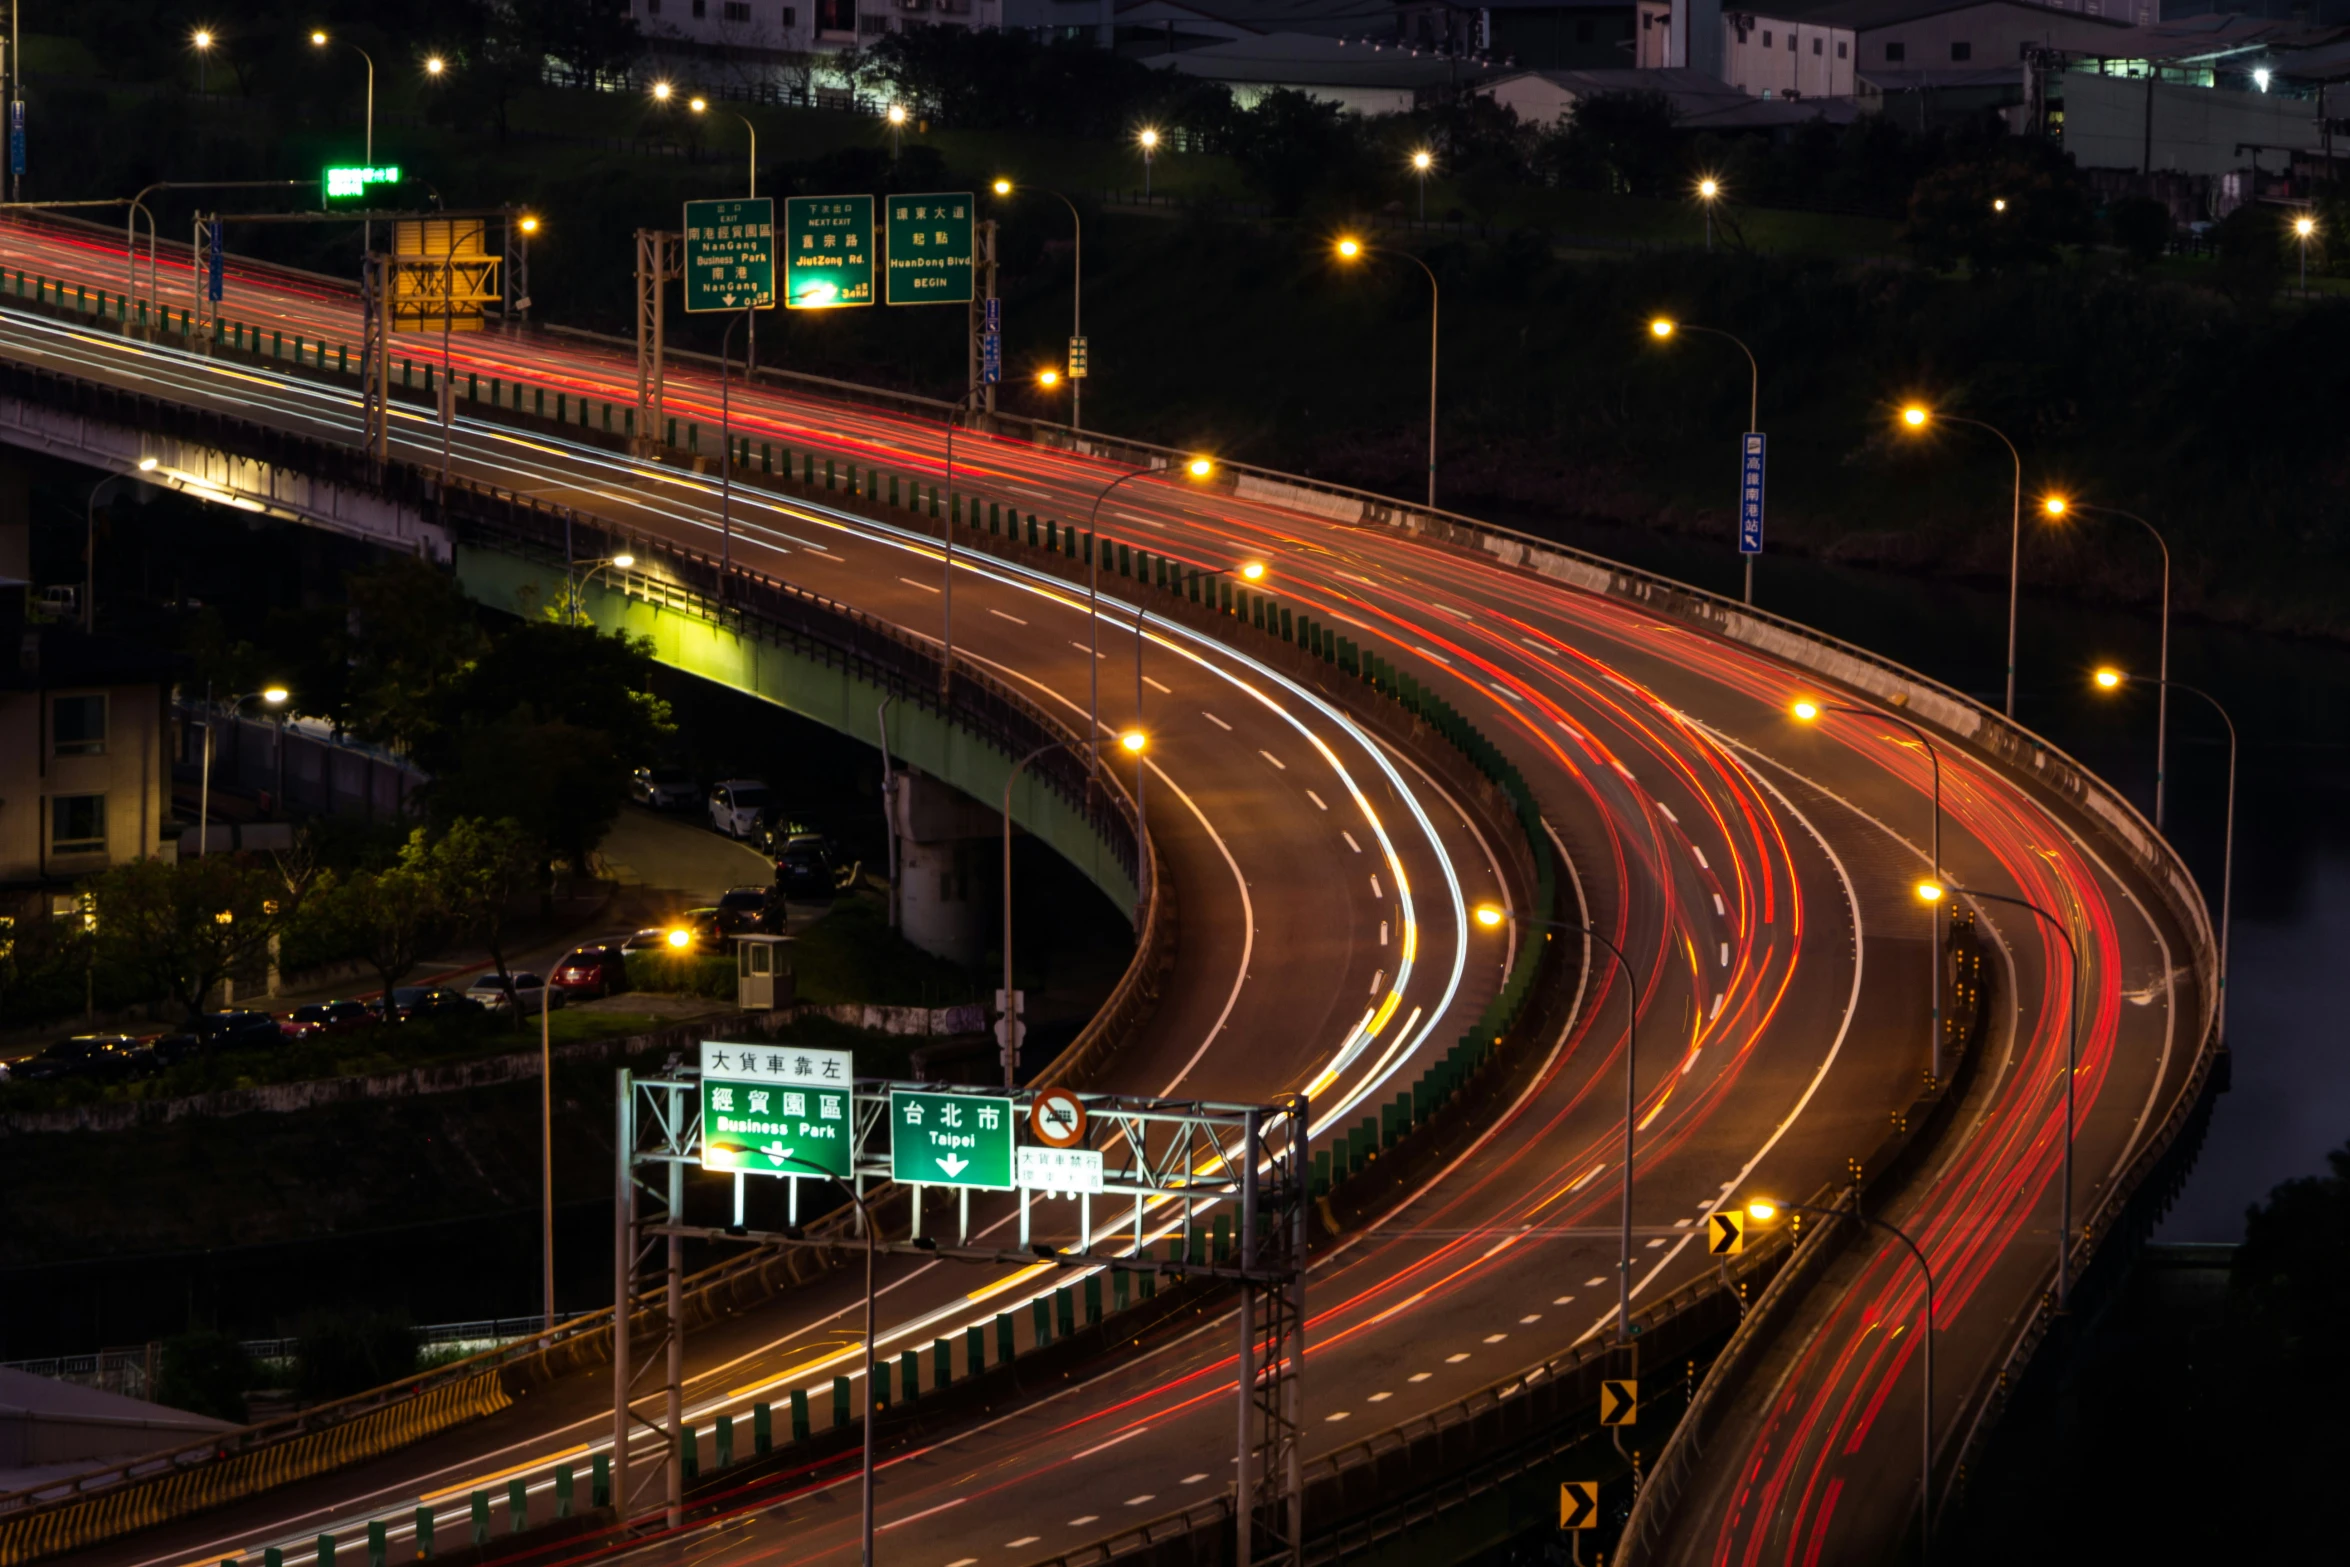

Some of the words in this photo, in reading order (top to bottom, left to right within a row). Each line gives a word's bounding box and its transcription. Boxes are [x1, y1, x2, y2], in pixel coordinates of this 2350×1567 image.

[810, 205, 851, 213] 下次出口
[897, 207, 964, 220] 環東大道
[689, 225, 770, 239] 南港經貿園區
[913, 232, 948, 245] 起點
[703, 242, 756, 251] NanGang
[803, 235, 857, 248] 舊宗路
[697, 256, 733, 265] Business
[742, 254, 765, 262] Park
[850, 255, 864, 263] Rd.
[891, 258, 944, 268] HuanDong
[713, 267, 746, 279] 南港
[704, 283, 756, 292] NanGang
[915, 279, 947, 287] BEGIN
[1745, 457, 1760, 532] 高鐵南港站
[712, 1050, 841, 1080] 大貨車靠左
[711, 1087, 842, 1120] 經貿園區
[903, 1100, 1000, 1130] 台北市
[717, 1116, 788, 1136] Business
[799, 1122, 836, 1139] Park
[929, 1131, 976, 1149] Taipei
[1022, 1152, 1098, 1169] 大貨車禁行
